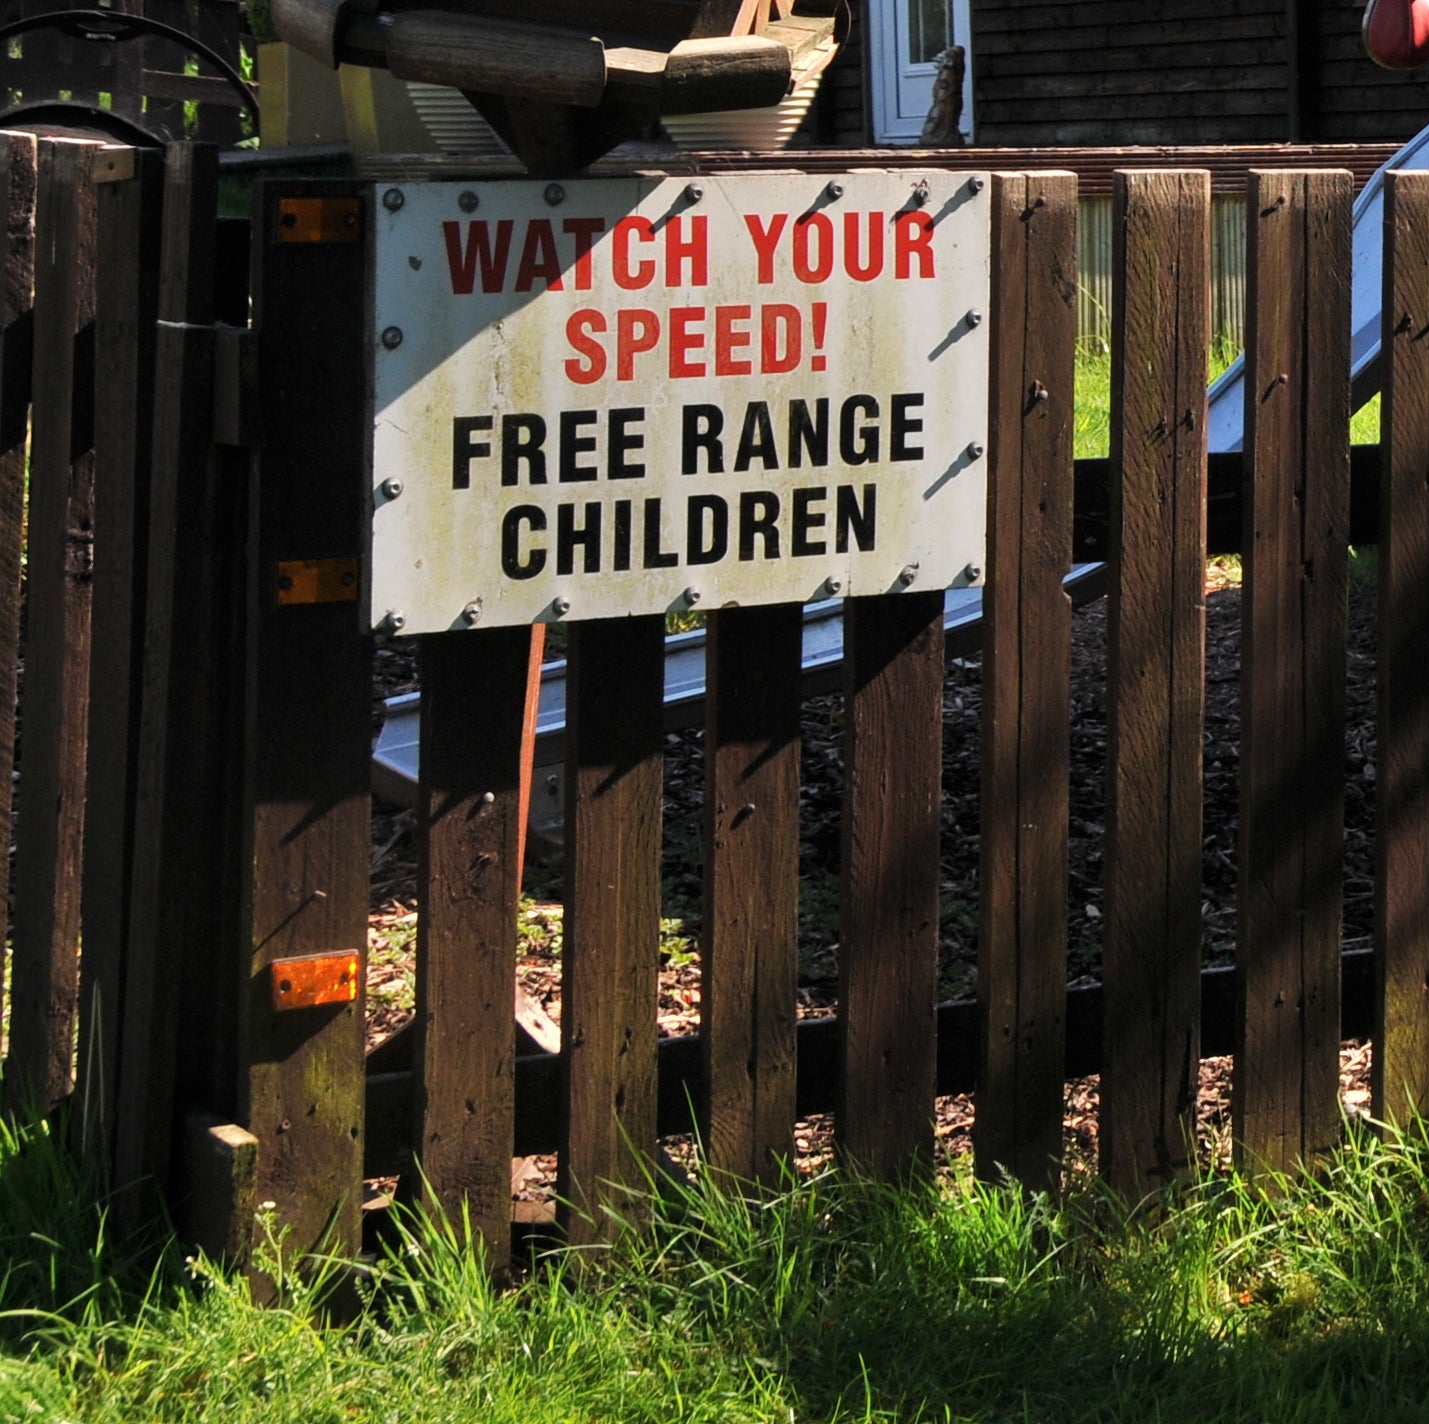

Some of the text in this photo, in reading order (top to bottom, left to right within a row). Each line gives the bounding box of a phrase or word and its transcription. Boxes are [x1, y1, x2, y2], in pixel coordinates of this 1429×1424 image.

[443, 210, 936, 295] WATCH YOUR
[565, 302, 829, 385] SPEED!
[452, 393, 925, 490] FREE RANGE
[501, 483, 877, 581] CHILDREN
